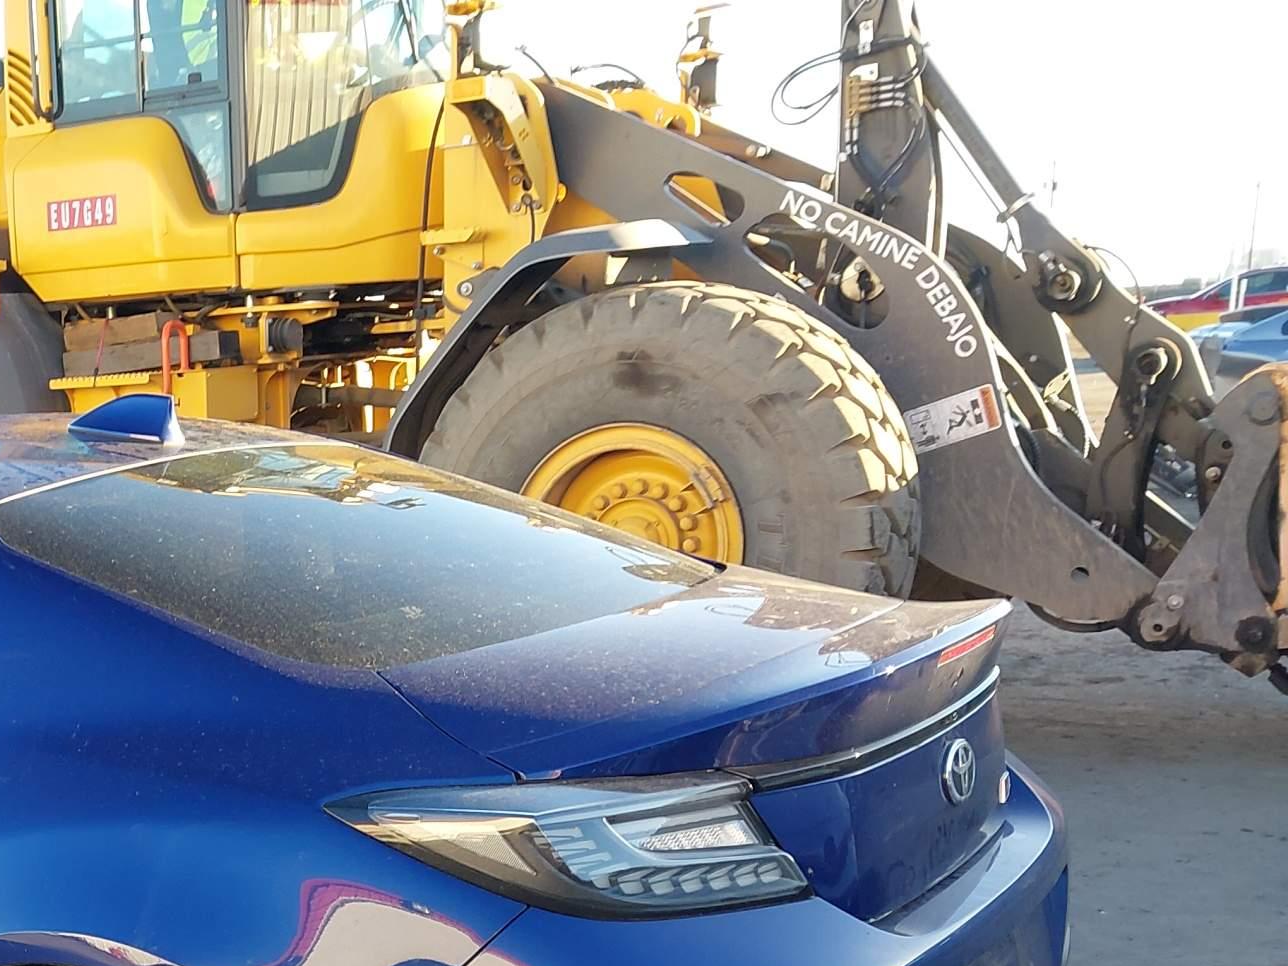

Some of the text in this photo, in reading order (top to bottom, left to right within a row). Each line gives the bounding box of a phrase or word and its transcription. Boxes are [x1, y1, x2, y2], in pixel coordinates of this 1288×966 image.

[50, 196, 114, 230] EU7G49
[779, 190, 978, 358] NO CAMINE DEBAJO
